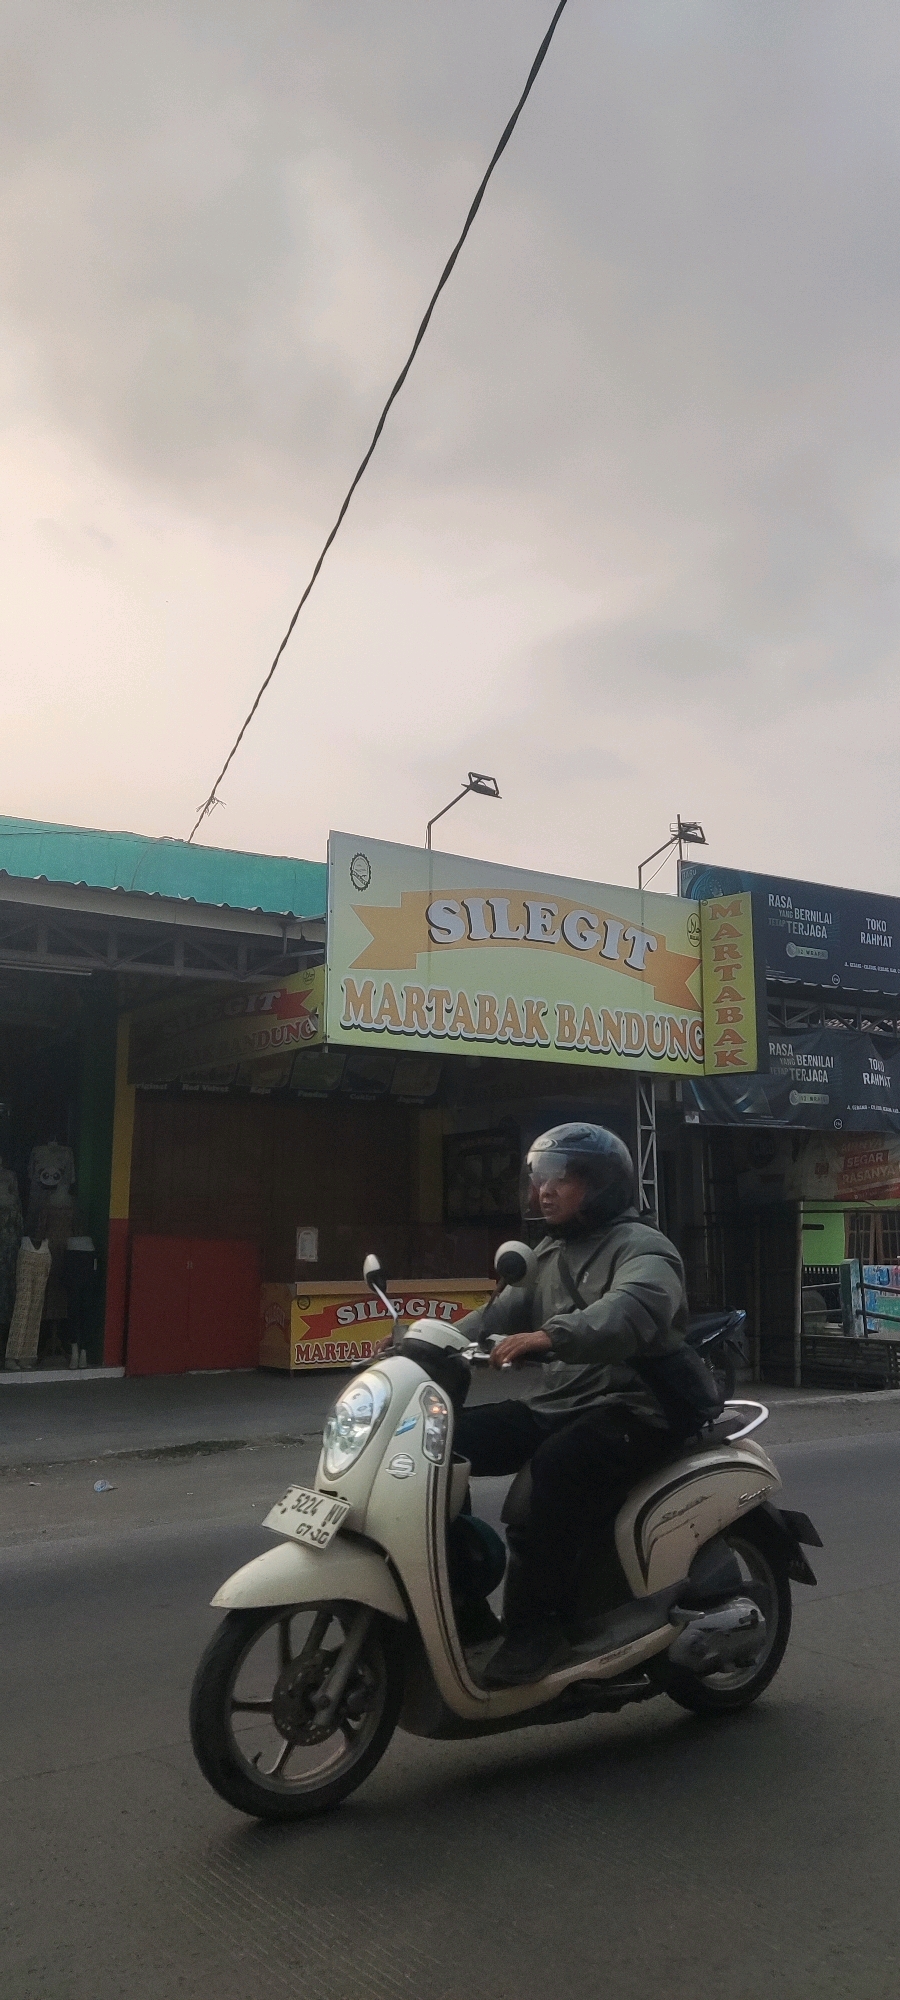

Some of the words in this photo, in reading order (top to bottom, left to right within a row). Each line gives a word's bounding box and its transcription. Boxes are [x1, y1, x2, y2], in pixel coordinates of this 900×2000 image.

[768, 893, 793, 910] RASA
[778, 909, 793, 919] YANG
[794, 907, 832, 925] BERNILAI
[426, 896, 658, 971] SILEGIT
[786, 920, 828, 939] TERJAGA
[866, 917, 887, 933] TOKO
[860, 931, 893, 948] RAHMAT
[709, 900, 748, 1067] MARTABAK
[340, 975, 551, 1056] MARTABAK
[555, 1001, 704, 1062] BANDUNG
[768, 1042, 794, 1057] RASA
[796, 1054, 834, 1069] BERNILAI
[789, 1067, 829, 1083] TERJAGA
[862, 1072, 891, 1088] RAHMAT
[846, 1152, 884, 1168] SEGAR
[842, 1164, 895, 1184] RASANYA
[336, 1298, 458, 1325] SILEGIT
[291, 1493, 325, 1517] 5224
